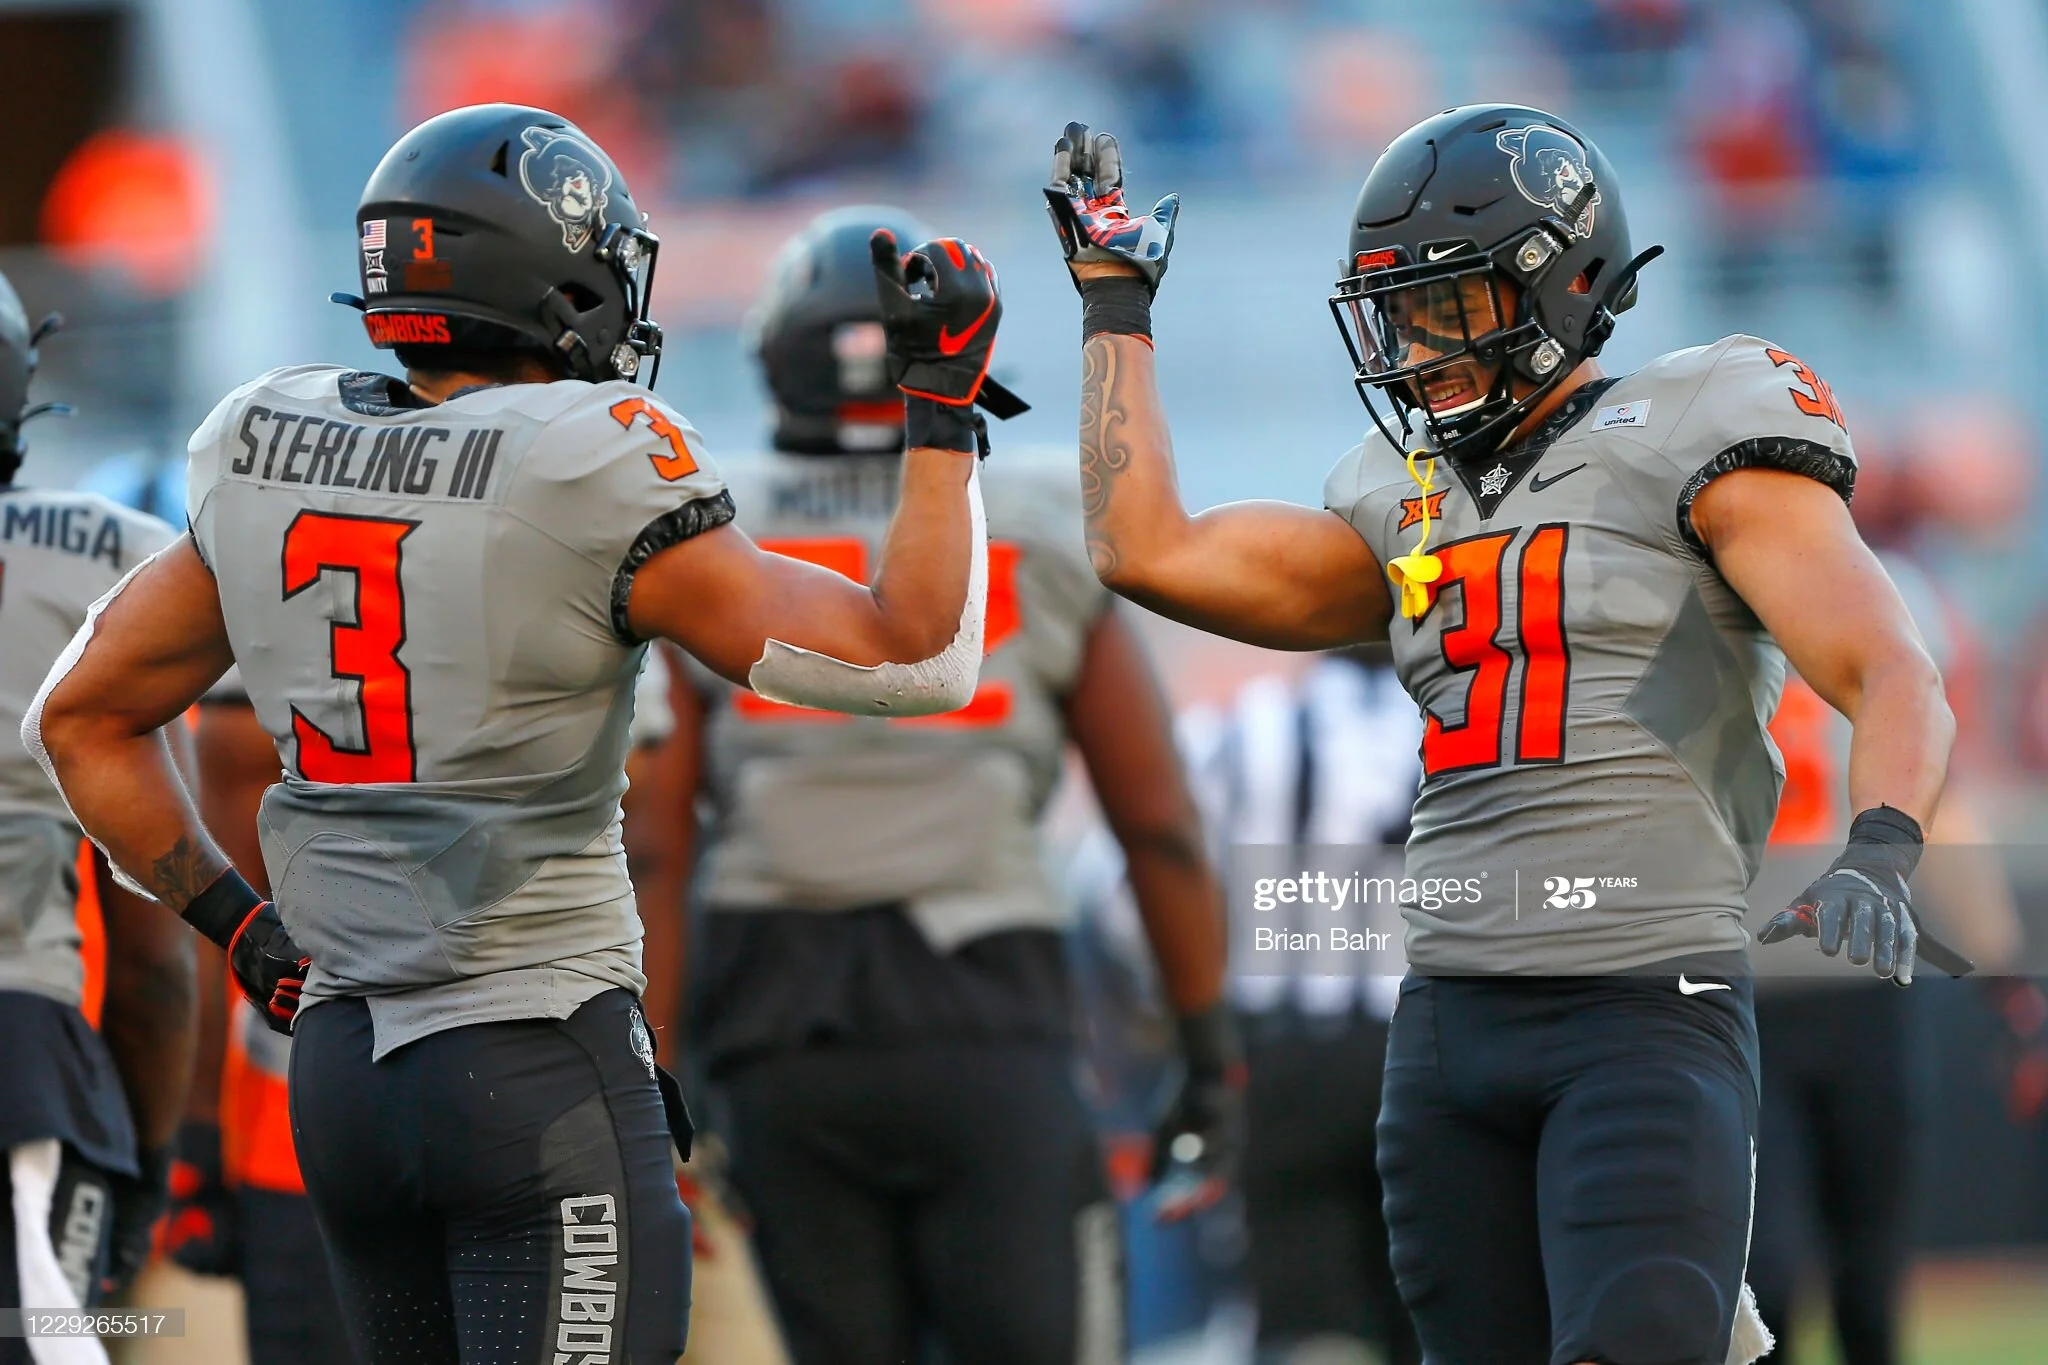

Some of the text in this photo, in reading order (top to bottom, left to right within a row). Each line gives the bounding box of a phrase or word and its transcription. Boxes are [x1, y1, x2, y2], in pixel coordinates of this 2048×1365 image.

[410, 218, 435, 260] 3
[366, 313, 452, 343] COWBOYS
[232, 405, 504, 500] STERLING III
[609, 397, 699, 482] 3
[1604, 416, 1637, 426] united
[281, 508, 423, 783] 3
[1412, 522, 1572, 784] 31
